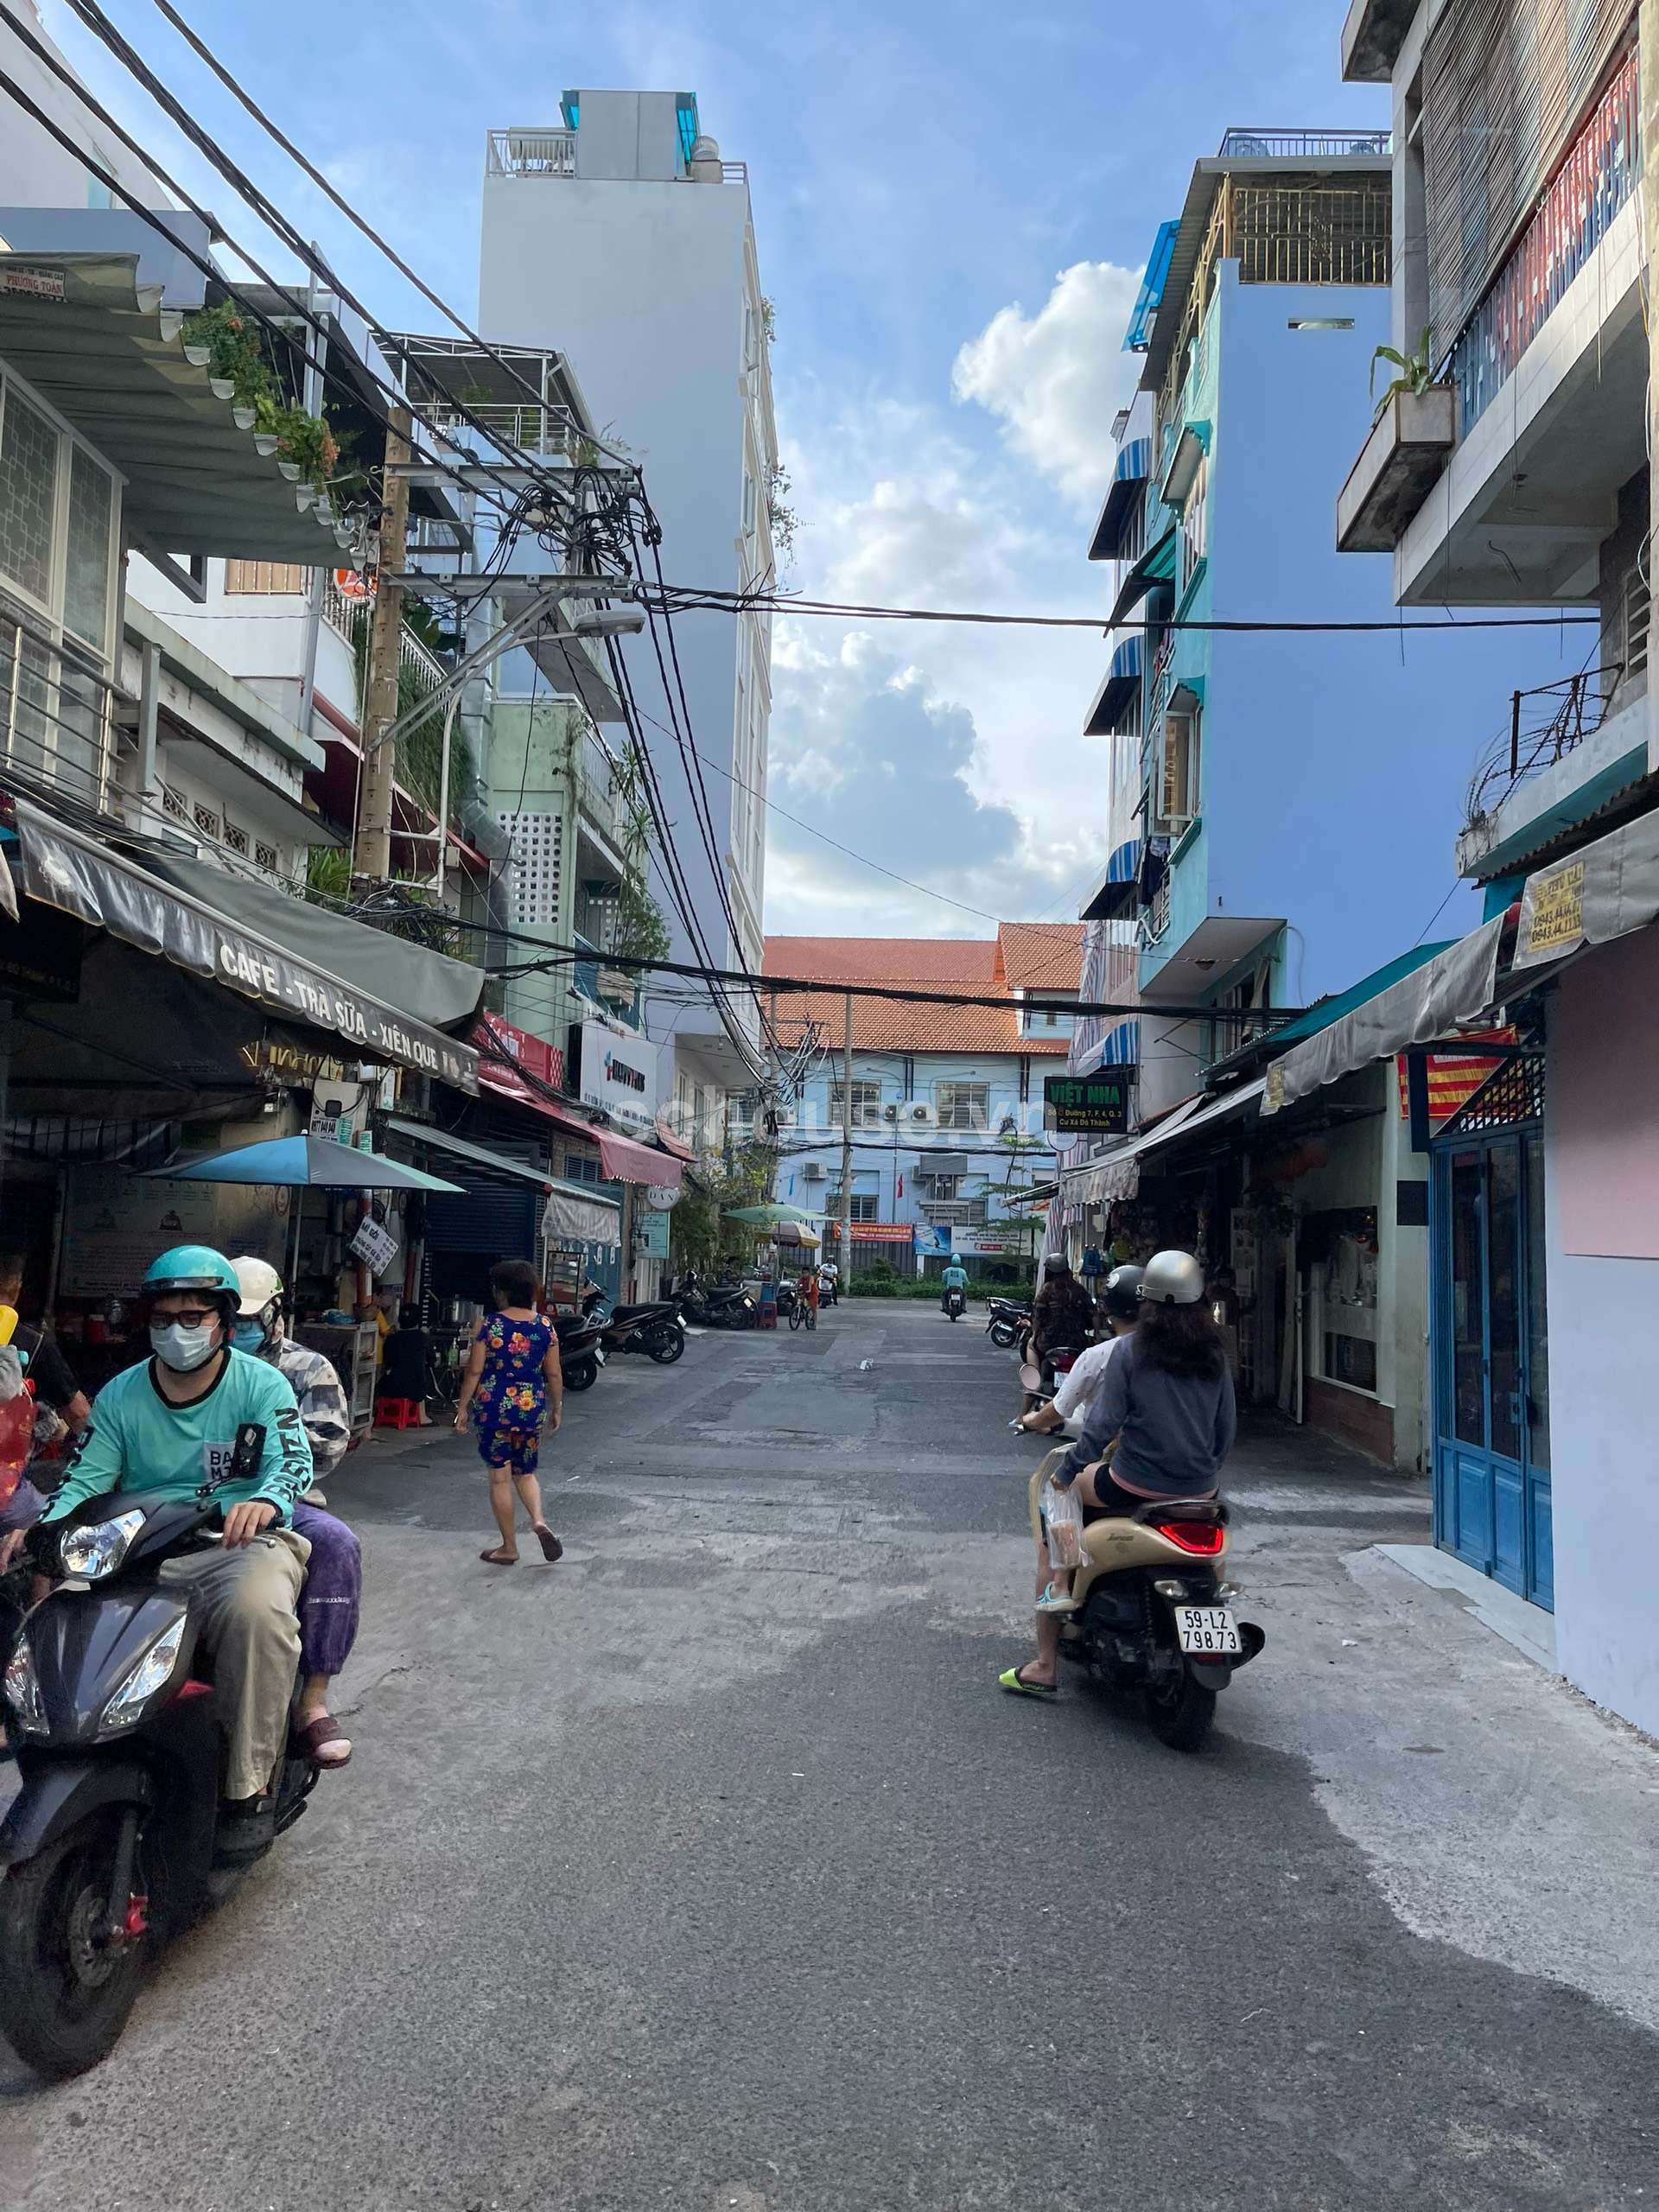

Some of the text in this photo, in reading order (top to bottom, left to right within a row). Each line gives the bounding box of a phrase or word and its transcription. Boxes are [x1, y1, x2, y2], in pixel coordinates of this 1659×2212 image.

[294, 980, 332, 1021] TRÀ
[334, 1001, 368, 1039] SỮA
[379, 1022, 412, 1058] XIÊN
[413, 1040, 439, 1071] QUE
[1051, 1081, 1084, 1107] VIỆT
[1185, 1610, 1229, 1630] 59-L2
[1183, 1630, 1236, 1649] 798.73
